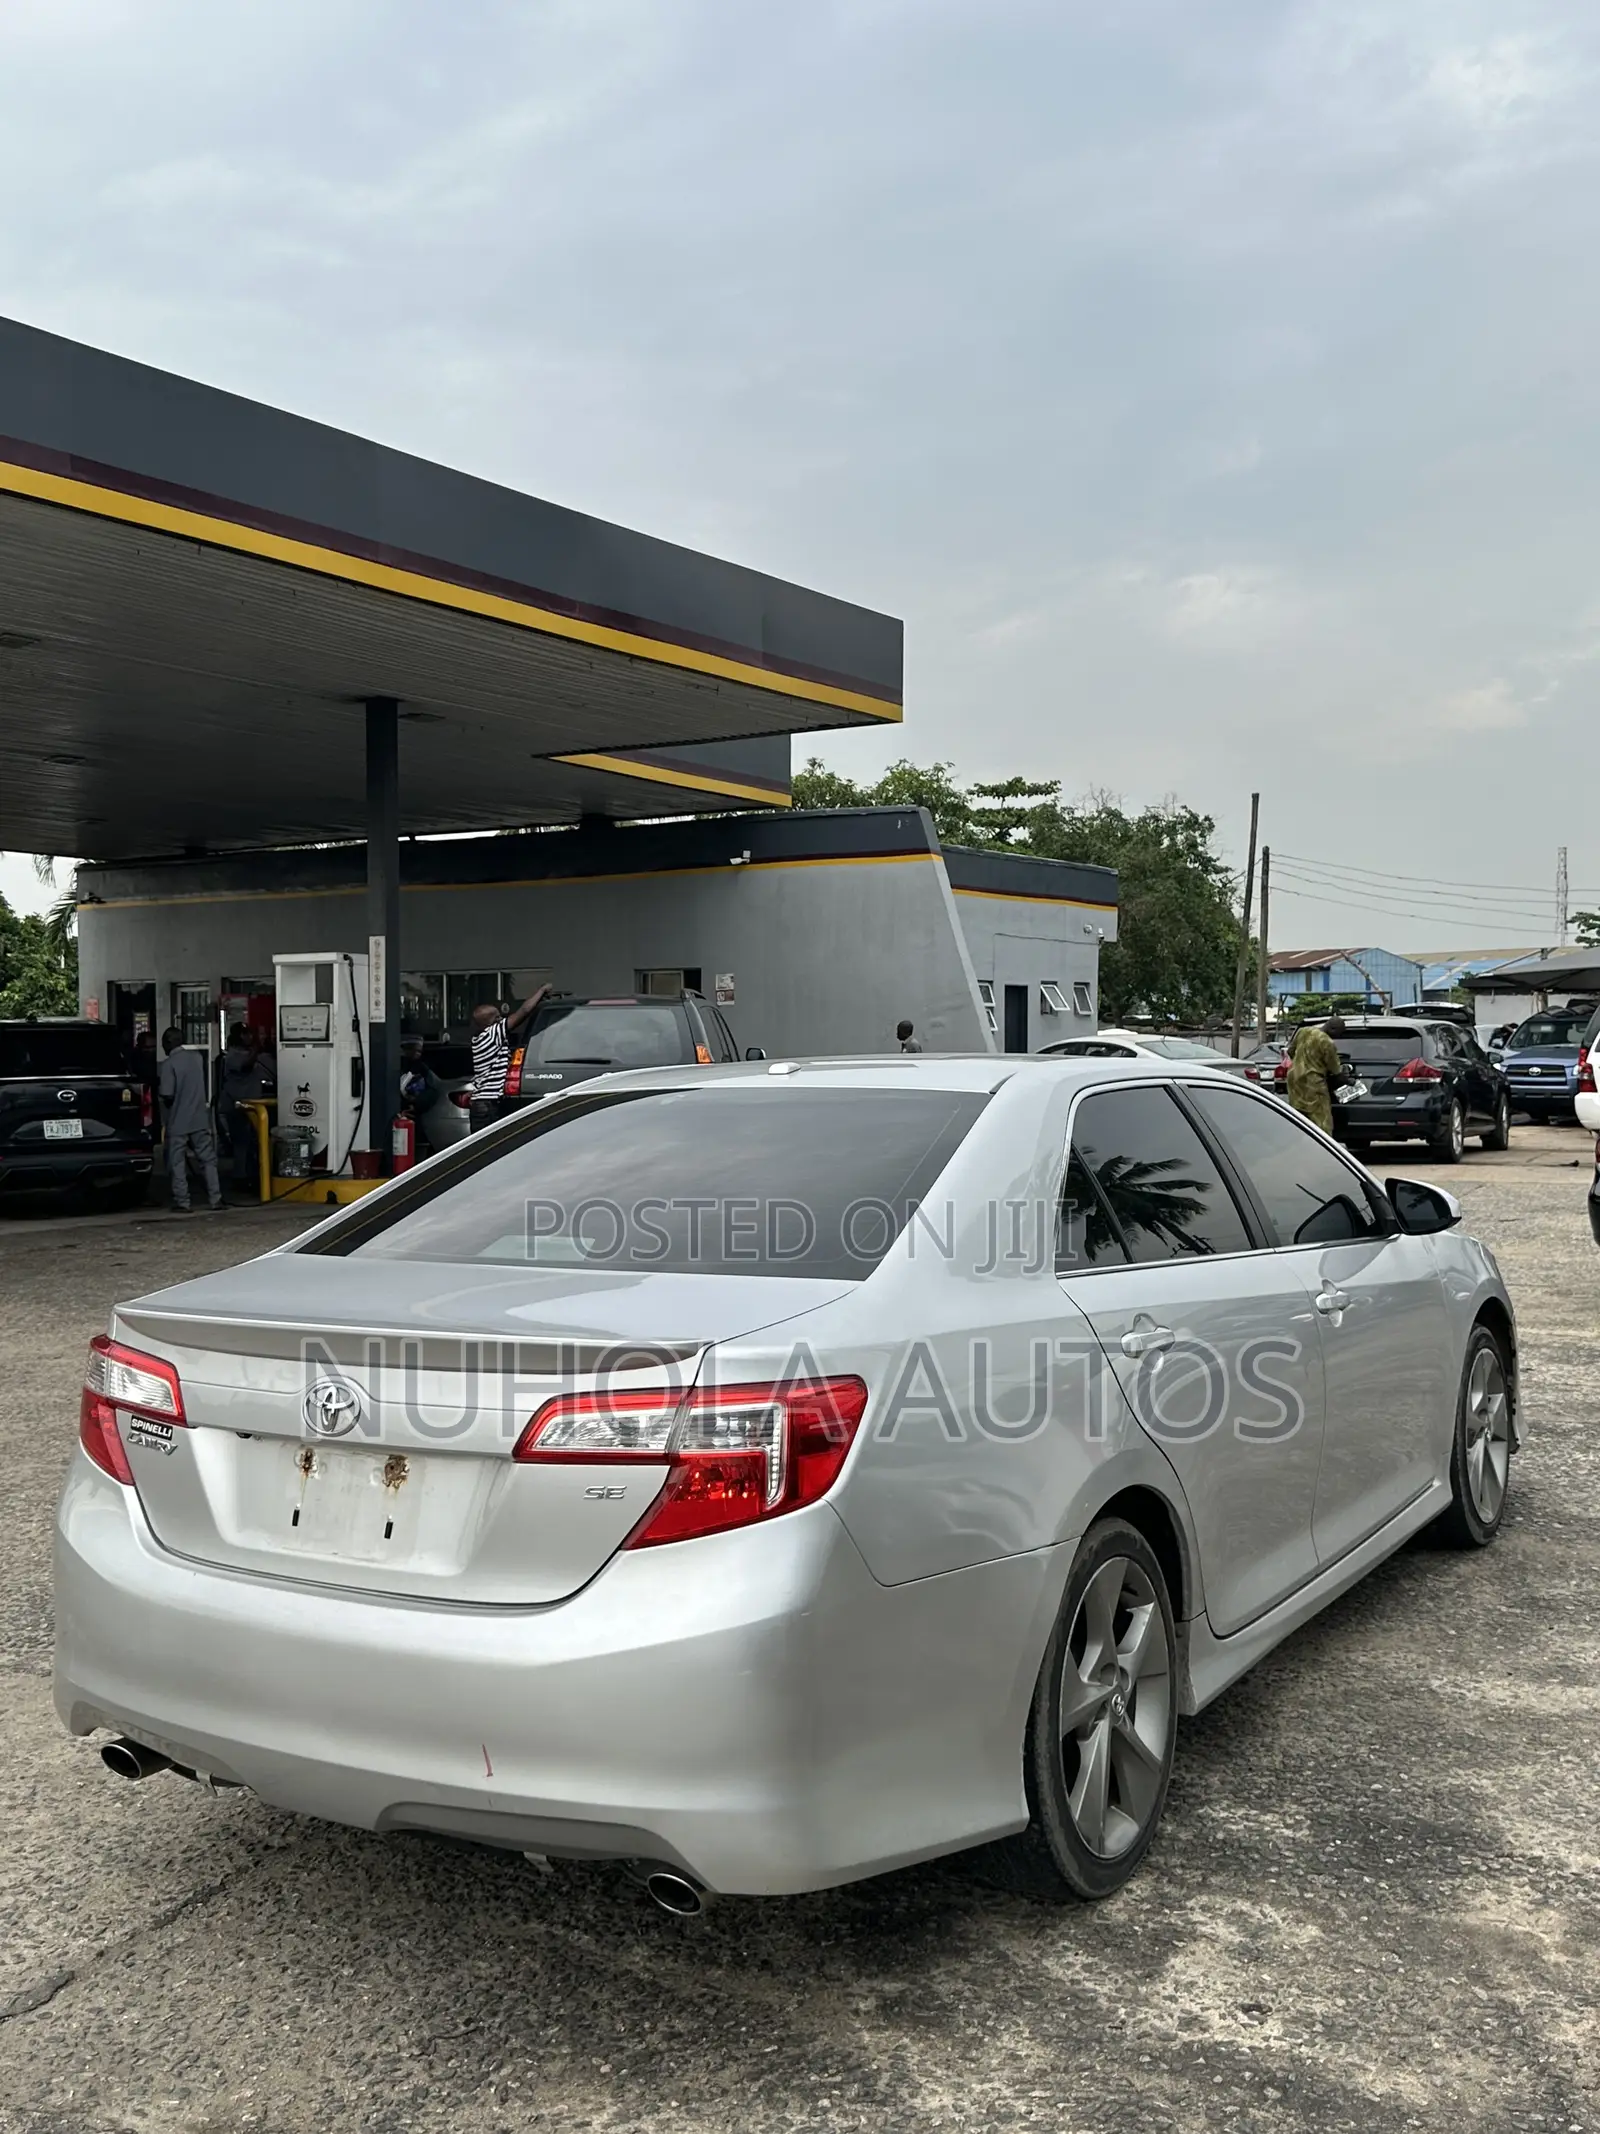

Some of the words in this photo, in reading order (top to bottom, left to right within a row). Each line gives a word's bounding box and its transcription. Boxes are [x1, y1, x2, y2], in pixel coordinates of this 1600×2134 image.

[293, 1104, 314, 1113] MRS
[131, 1418, 172, 1438] SPINELLI
[582, 1485, 627, 1500] SE
